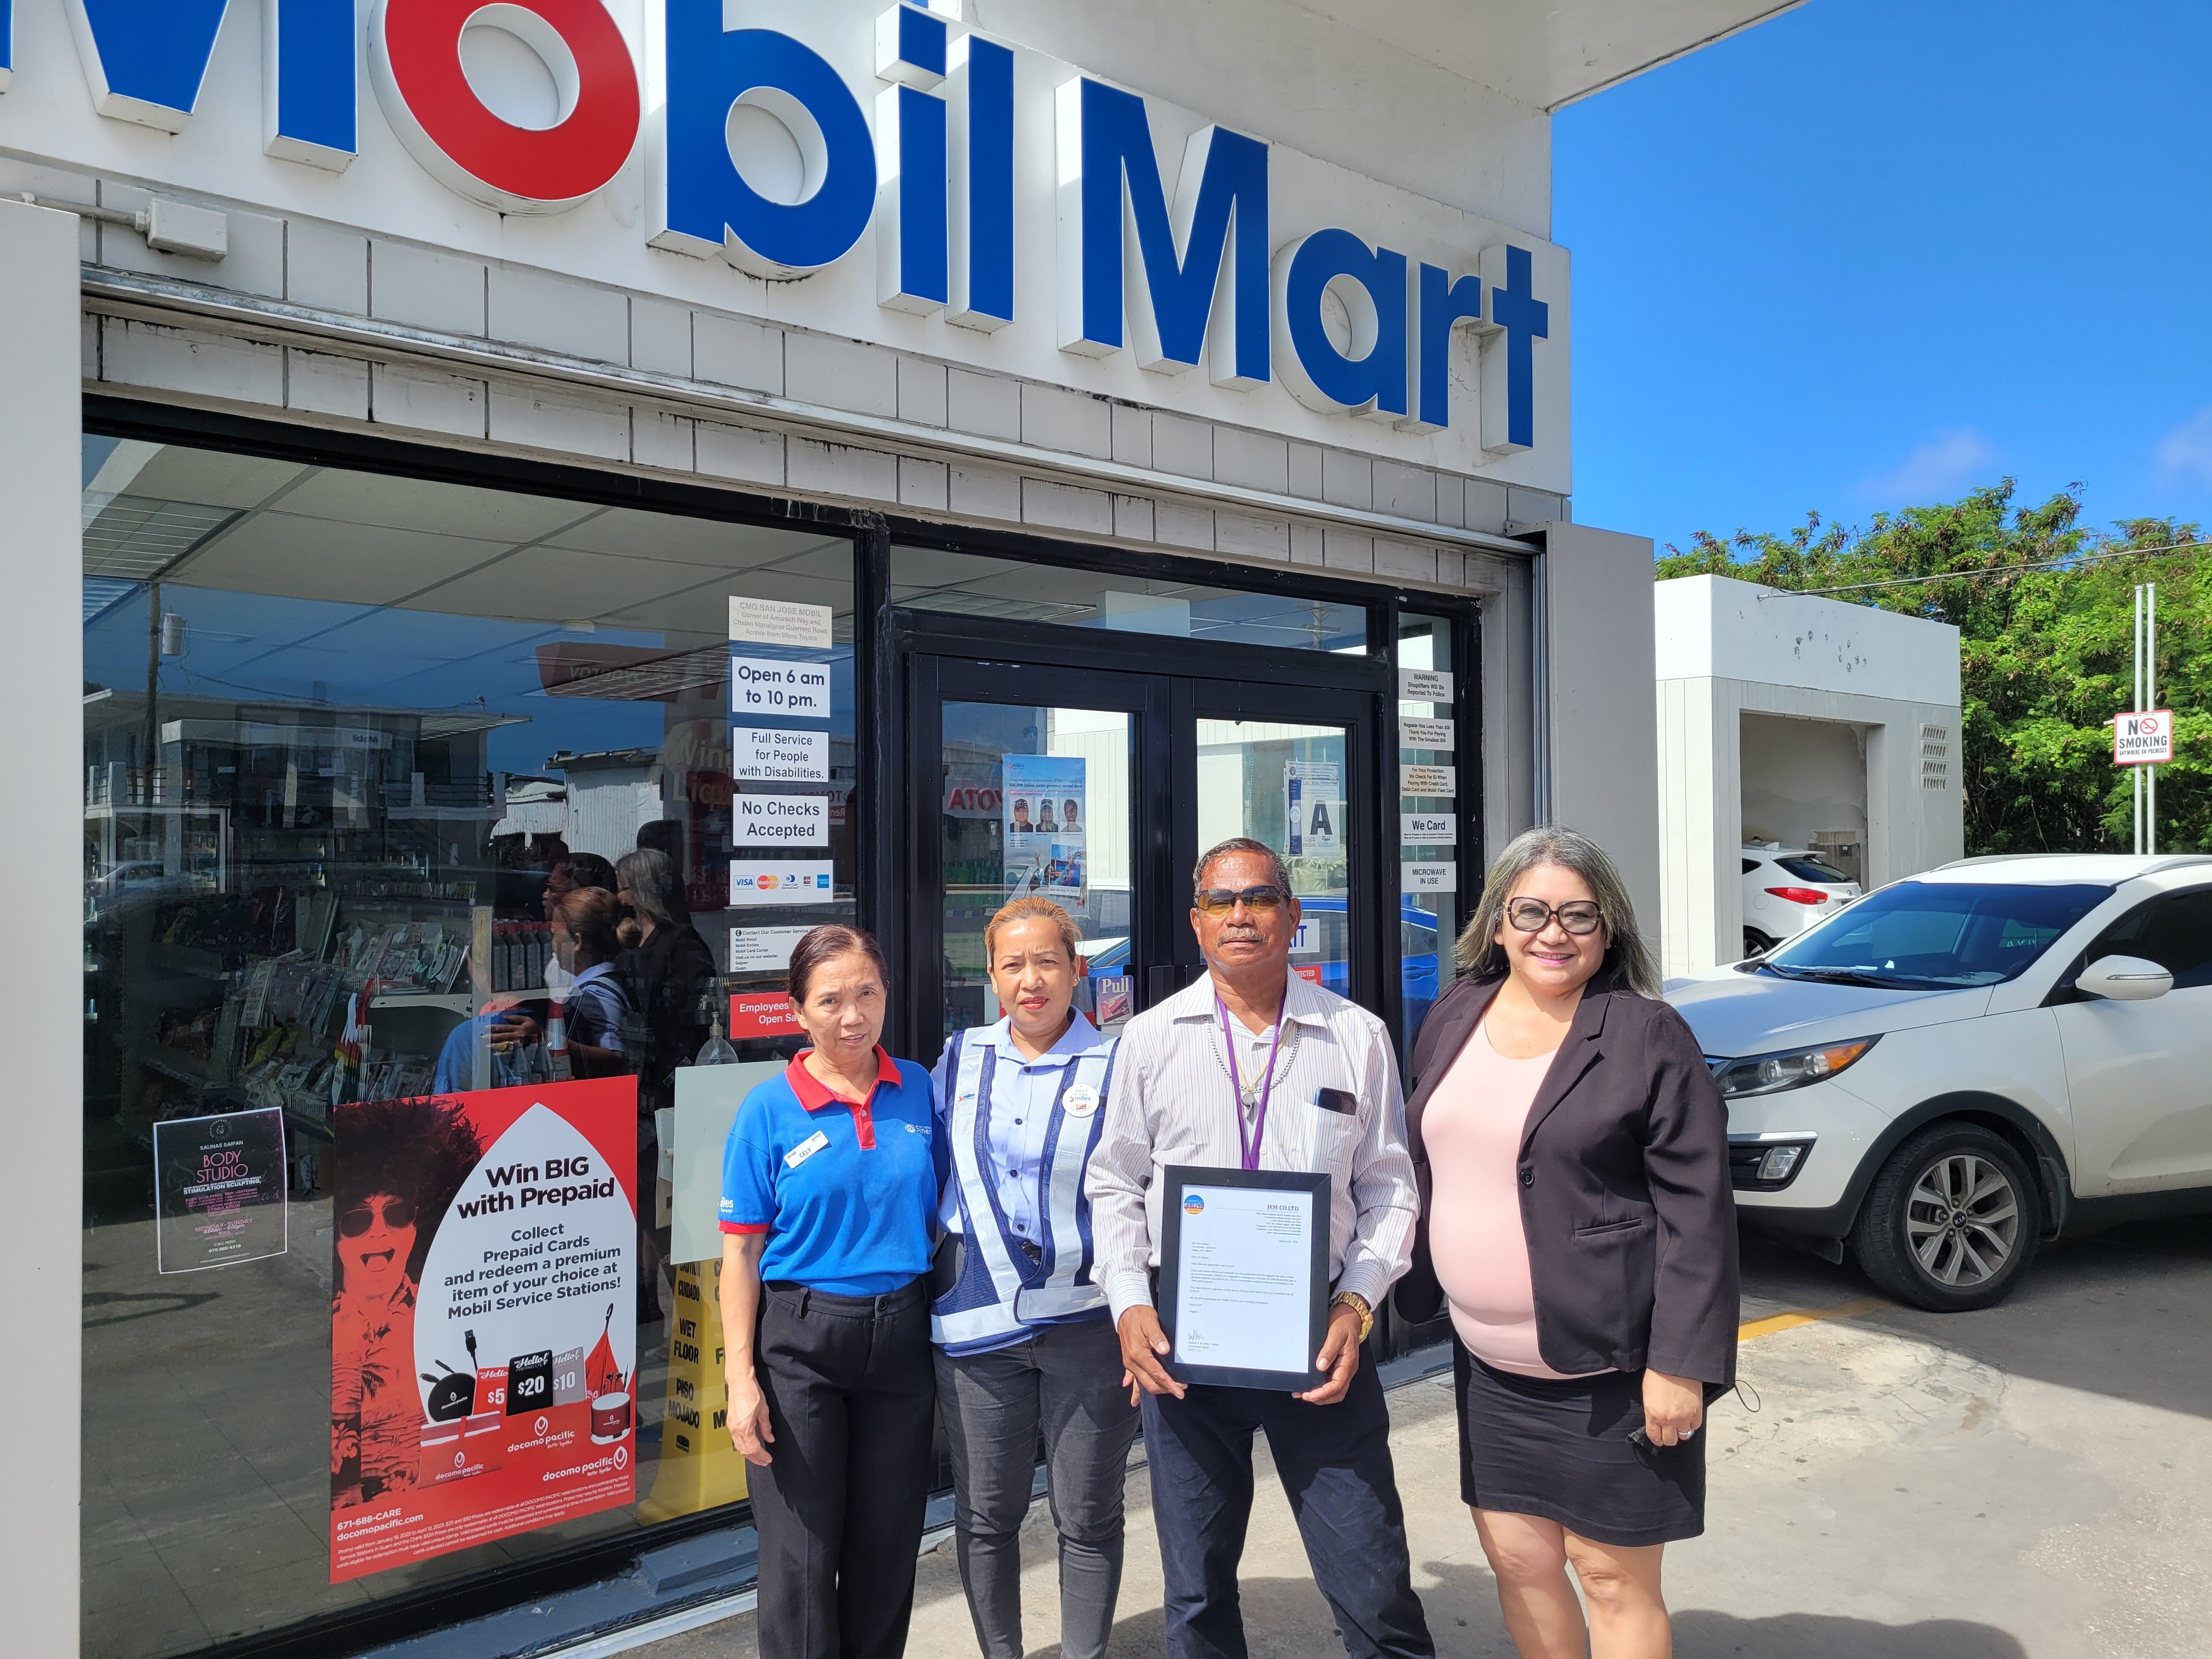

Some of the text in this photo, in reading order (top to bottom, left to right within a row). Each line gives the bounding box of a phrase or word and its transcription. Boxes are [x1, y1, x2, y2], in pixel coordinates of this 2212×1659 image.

[1059, 76, 1549, 455] Mart
[740, 602, 822, 617] CMG SAN JOSE MOBIL
[786, 624, 811, 633] Guerrero
[812, 627, 828, 635] Road,
[738, 665, 825, 686] Open 6 am
[1413, 673, 1439, 682] WARNING
[1408, 682, 1430, 691] Shoplifters
[746, 689, 817, 709] to 10 pm.
[752, 732, 812, 746] Full Service
[2119, 735, 2168, 749] SMOKING
[755, 749, 809, 764] for People
[739, 765, 825, 779] with Disabilities.
[742, 800, 820, 816] No Checks
[1310, 799, 1333, 835] A
[746, 822, 815, 840] Accepted
[1412, 820, 1446, 831] We Card
[736, 878, 754, 887] VISA
[1295, 969, 1315, 978] TECTED
[1102, 978, 1130, 995] Pull
[739, 1002, 789, 1014] Employees
[759, 1014, 783, 1026] Open
[200, 1139, 244, 1151] SALINAS SAIPAN
[799, 1147, 811, 1158] CELY
[203, 1150, 242, 1168] BODY
[196, 1164, 249, 1184] STUDIO
[485, 1156, 589, 1188] Win BIG
[183, 1183, 225, 1195] STIMULATION
[227, 1178, 262, 1189] SCULPTING,
[456, 1177, 615, 1219] with Prepaid
[195, 1218, 253, 1232] MONDAY-SUNDAY
[1954, 1215, 1966, 1224] KIA
[511, 1223, 564, 1242] Collect
[483, 1235, 590, 1263] Prepaid Cards
[444, 1247, 621, 1286] and redeem a premium
[452, 1262, 618, 1302] item of your choice at
[678, 1279, 700, 1302] CUIDADO
[448, 1276, 622, 1319] Mobil Service Stations!
[679, 1317, 697, 1339] WET
[516, 1352, 550, 1369] Hello!
[674, 1340, 699, 1364] FLOOR
[480, 1369, 509, 1380] Hello
[553, 1371, 575, 1391] $10
[518, 1375, 545, 1397] $20
[676, 1378, 695, 1402] PISO
[487, 1387, 505, 1404] $5
[668, 1399, 700, 1429] MOJADO
[507, 1429, 575, 1452] docomo pacific
[435, 1463, 484, 1481] docomo pacific
[542, 1456, 613, 1482] docomo pacific
[337, 1508, 402, 1531] 671-688-CARE
[337, 1514, 424, 1542] docomopacific.com
